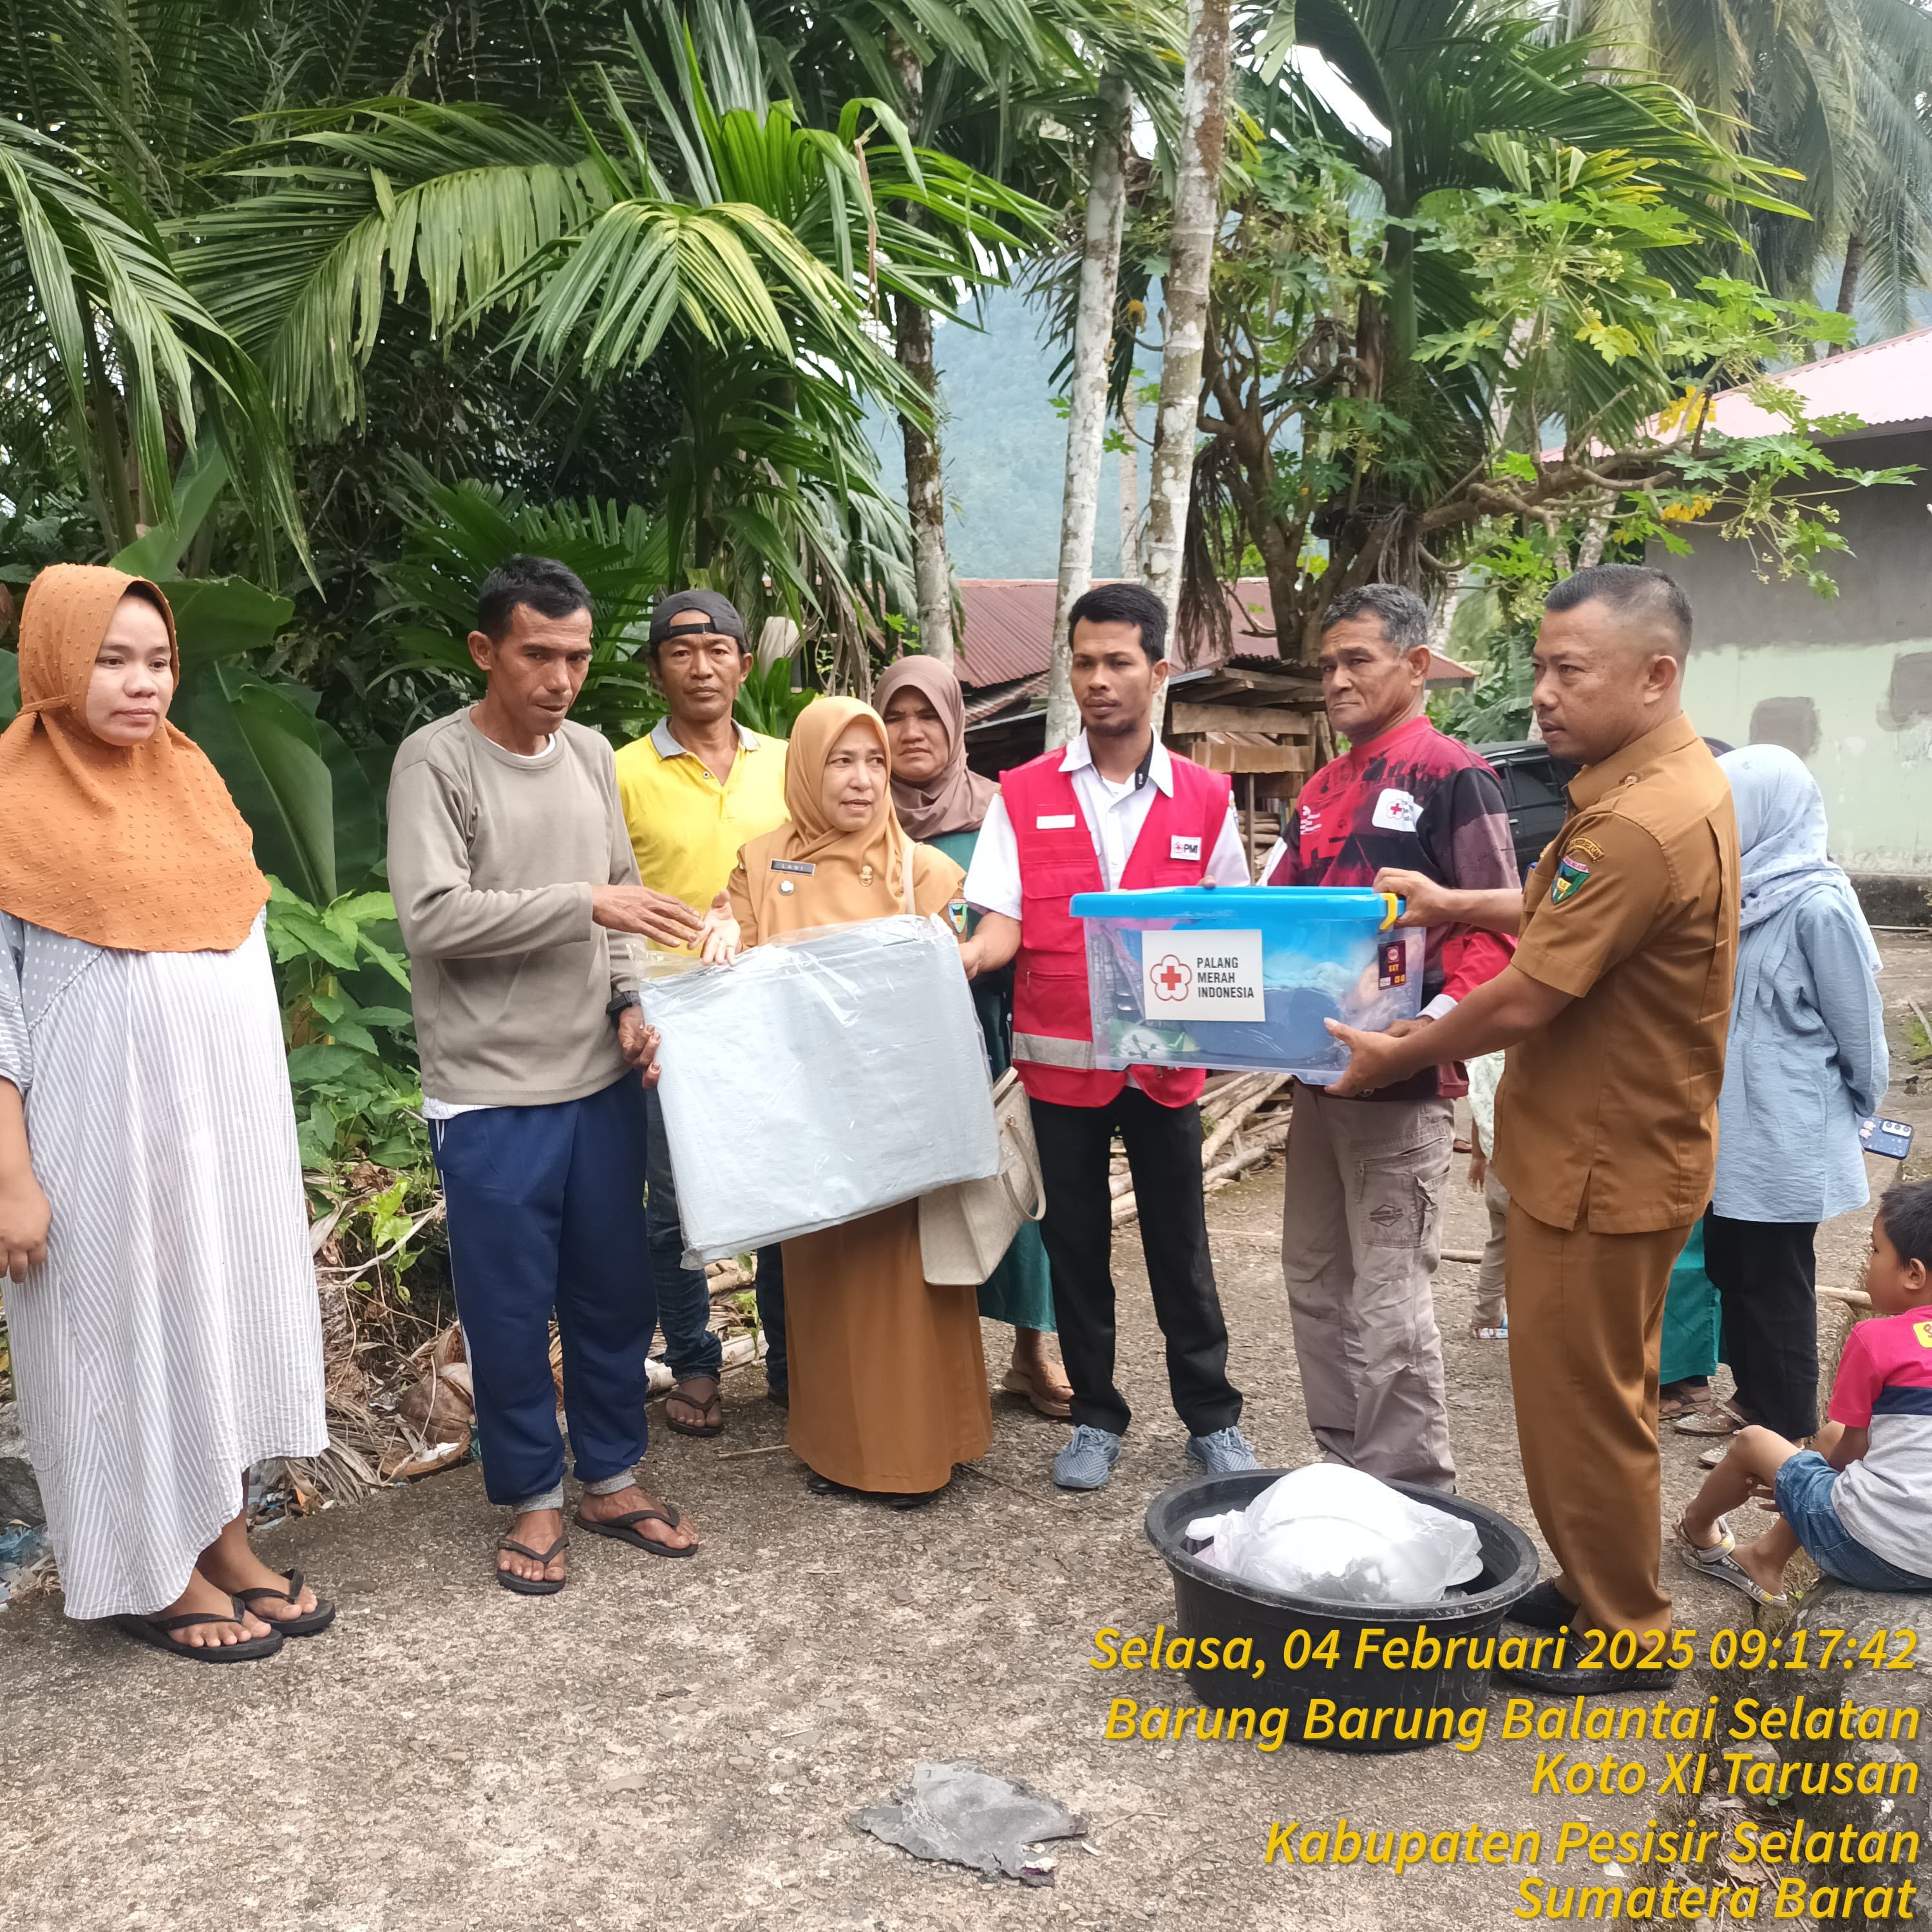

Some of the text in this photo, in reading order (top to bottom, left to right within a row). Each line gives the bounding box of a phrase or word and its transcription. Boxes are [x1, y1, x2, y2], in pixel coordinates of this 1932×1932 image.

[1184, 844, 1198, 853] PMI
[1197, 957, 1238, 969] PALANG
[1197, 972, 1235, 983] MERAH
[1198, 987, 1255, 998] INDONESIA
